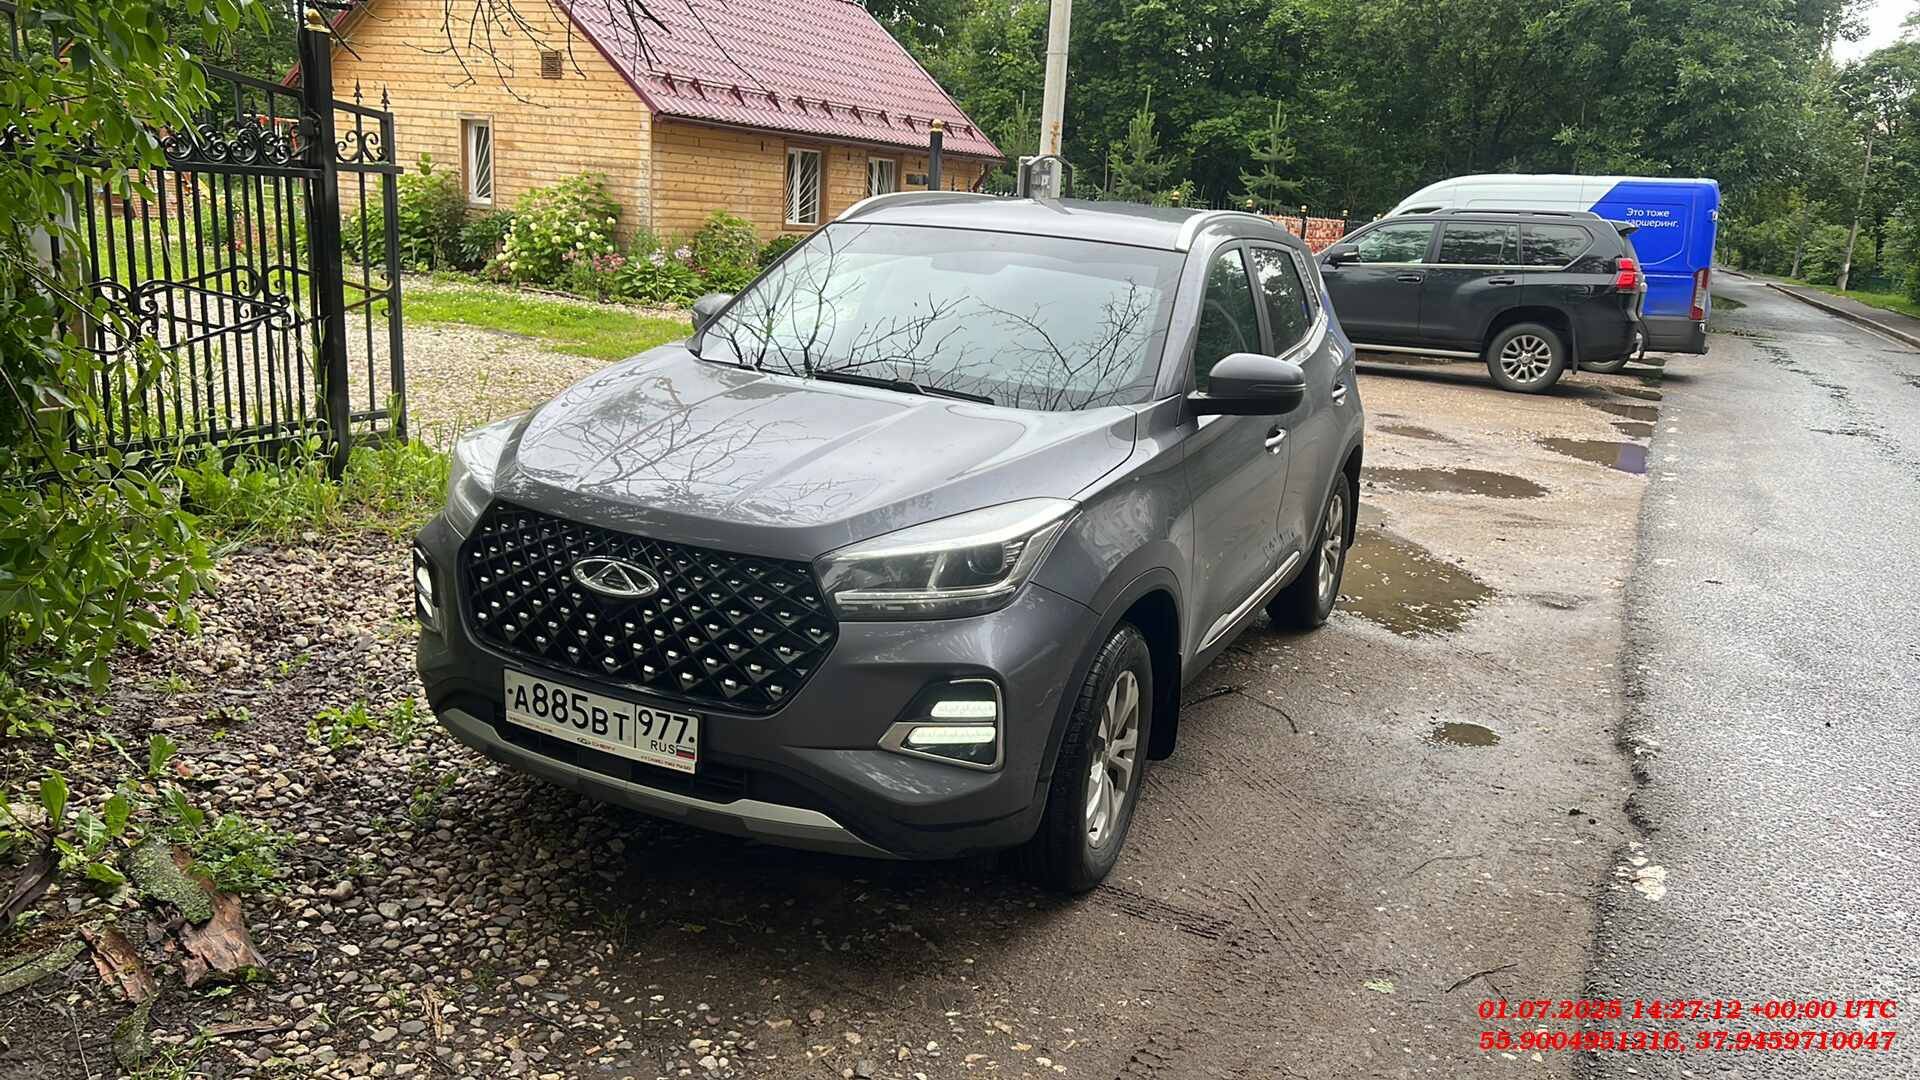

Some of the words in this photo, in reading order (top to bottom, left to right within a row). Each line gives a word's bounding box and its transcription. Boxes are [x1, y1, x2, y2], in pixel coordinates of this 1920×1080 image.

[1626, 207, 1644, 217] Это
[638, 709, 689, 744] 977
[650, 740, 675, 754] RUS
